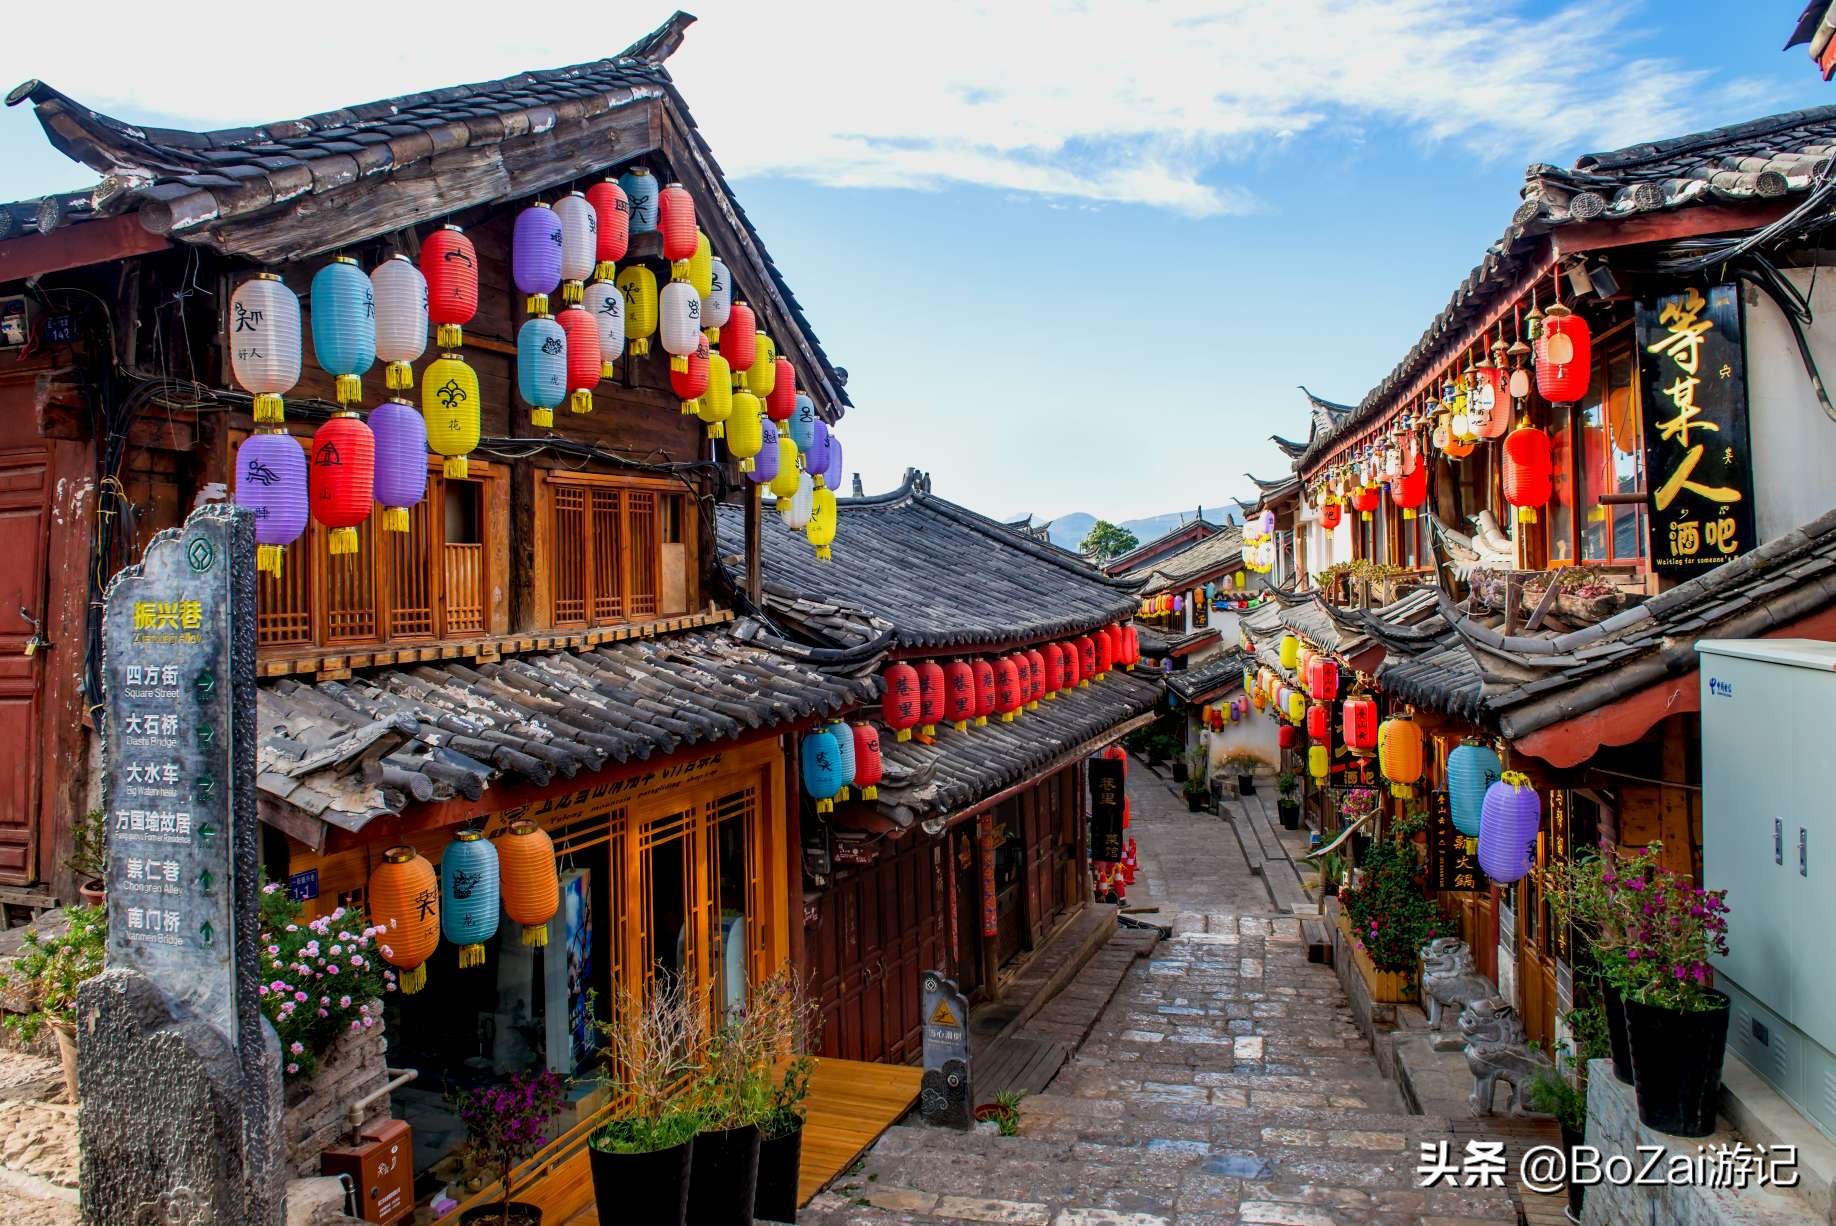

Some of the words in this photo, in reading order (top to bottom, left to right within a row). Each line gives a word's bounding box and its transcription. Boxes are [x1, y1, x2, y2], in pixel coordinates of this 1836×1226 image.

[239, 347, 264, 360] 好人
[1648, 287, 1742, 511] 等某人
[448, 419, 461, 432] 花
[1669, 517, 1739, 556] 酒吧
[133, 600, 202, 630] 振兴巷
[126, 665, 179, 686] 四方街
[124, 688, 153, 699] Square
[154, 688, 180, 698] Street
[126, 712, 179, 736] 大石桥
[151, 737, 177, 748] Bridge
[127, 761, 179, 785] 大水车
[115, 809, 191, 834] 方国瑜故居
[127, 858, 180, 881] 崇仁巷
[123, 880, 161, 893] Chongren
[163, 883, 183, 896] Alley
[128, 907, 180, 933] 南门桥
[159, 933, 183, 947] Bridge
